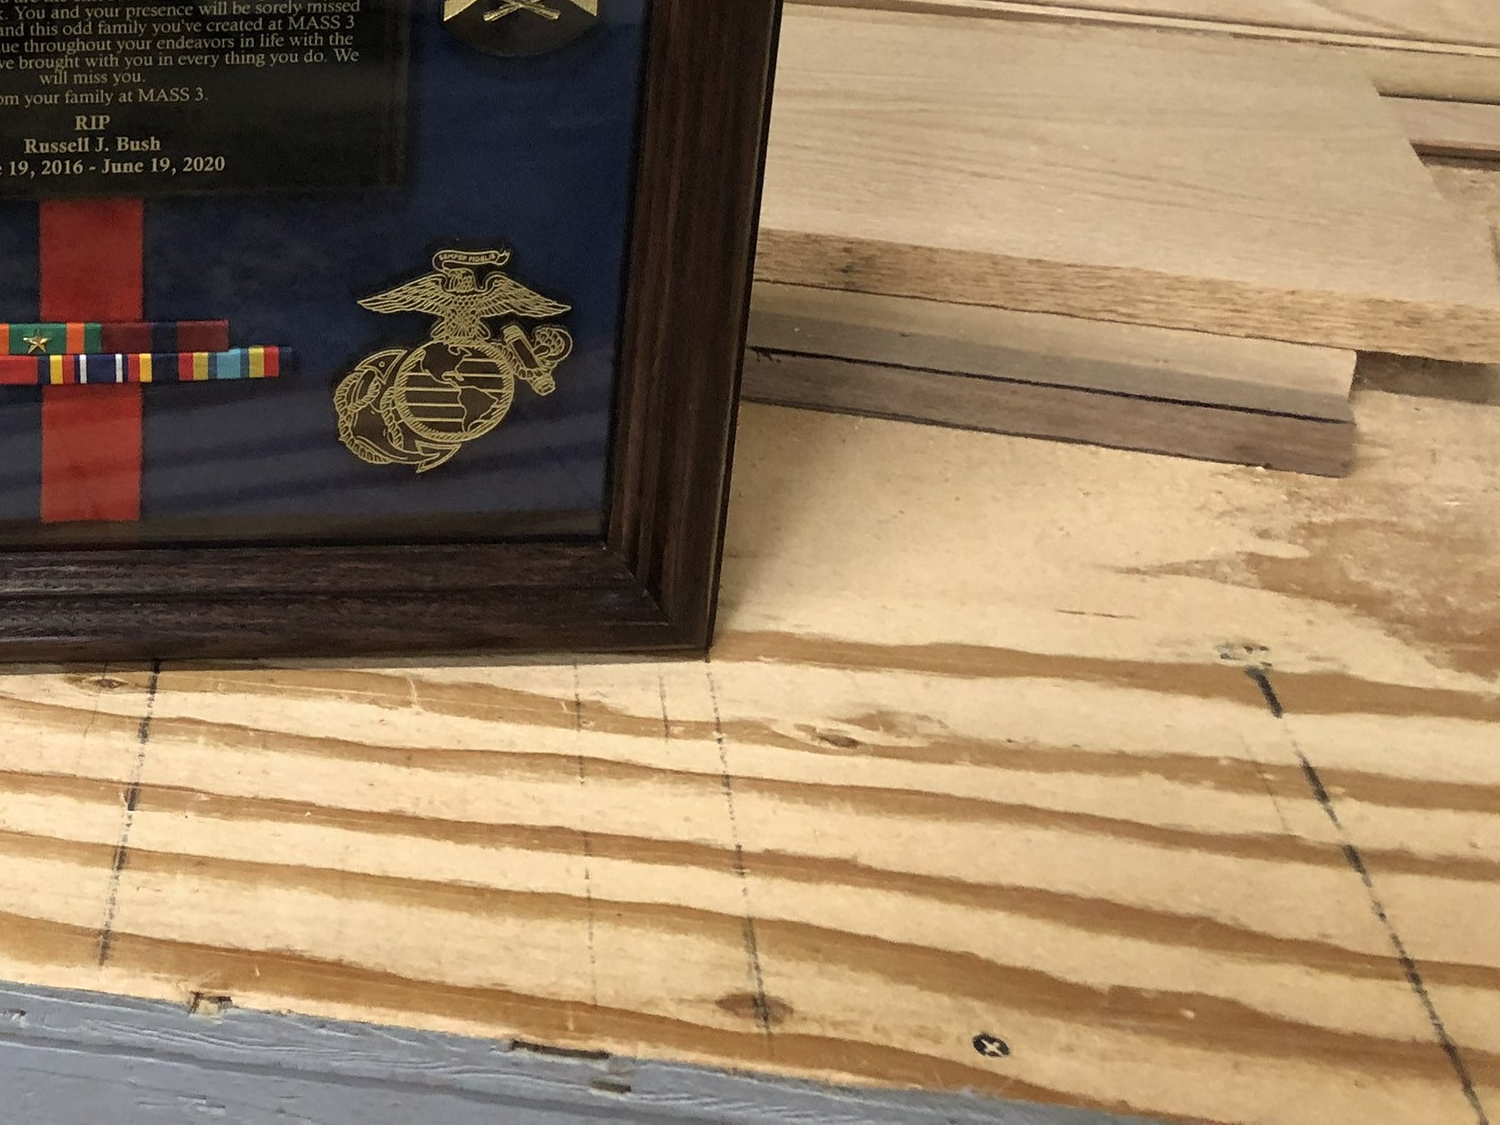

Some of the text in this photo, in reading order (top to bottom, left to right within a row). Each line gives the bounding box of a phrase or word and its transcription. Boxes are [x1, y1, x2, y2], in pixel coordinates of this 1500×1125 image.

[23, 37, 111, 56] throughout
[116, 39, 152, 54] your
[156, 34, 235, 49] endeavors
[240, 34, 254, 47] in
[259, 33, 284, 47] life
[289, 32, 323, 46] with
[328, 31, 353, 45] the
[38, 70, 145, 87] will miss you.
[24, 94, 60, 109] your
[64, 89, 114, 108] family
[118, 88, 133, 103] at
[138, 87, 190, 102] MASS
[194, 87, 208, 101] 3.
[74, 114, 110, 130] RIP
[23, 135, 161, 153] Russell J. Bush
[9, 161, 35, 177] 19,
[41, 160, 83, 175] 2016
[101, 158, 144, 174] June
[151, 157, 176, 174] 19,
[182, 156, 225, 172] 2020
